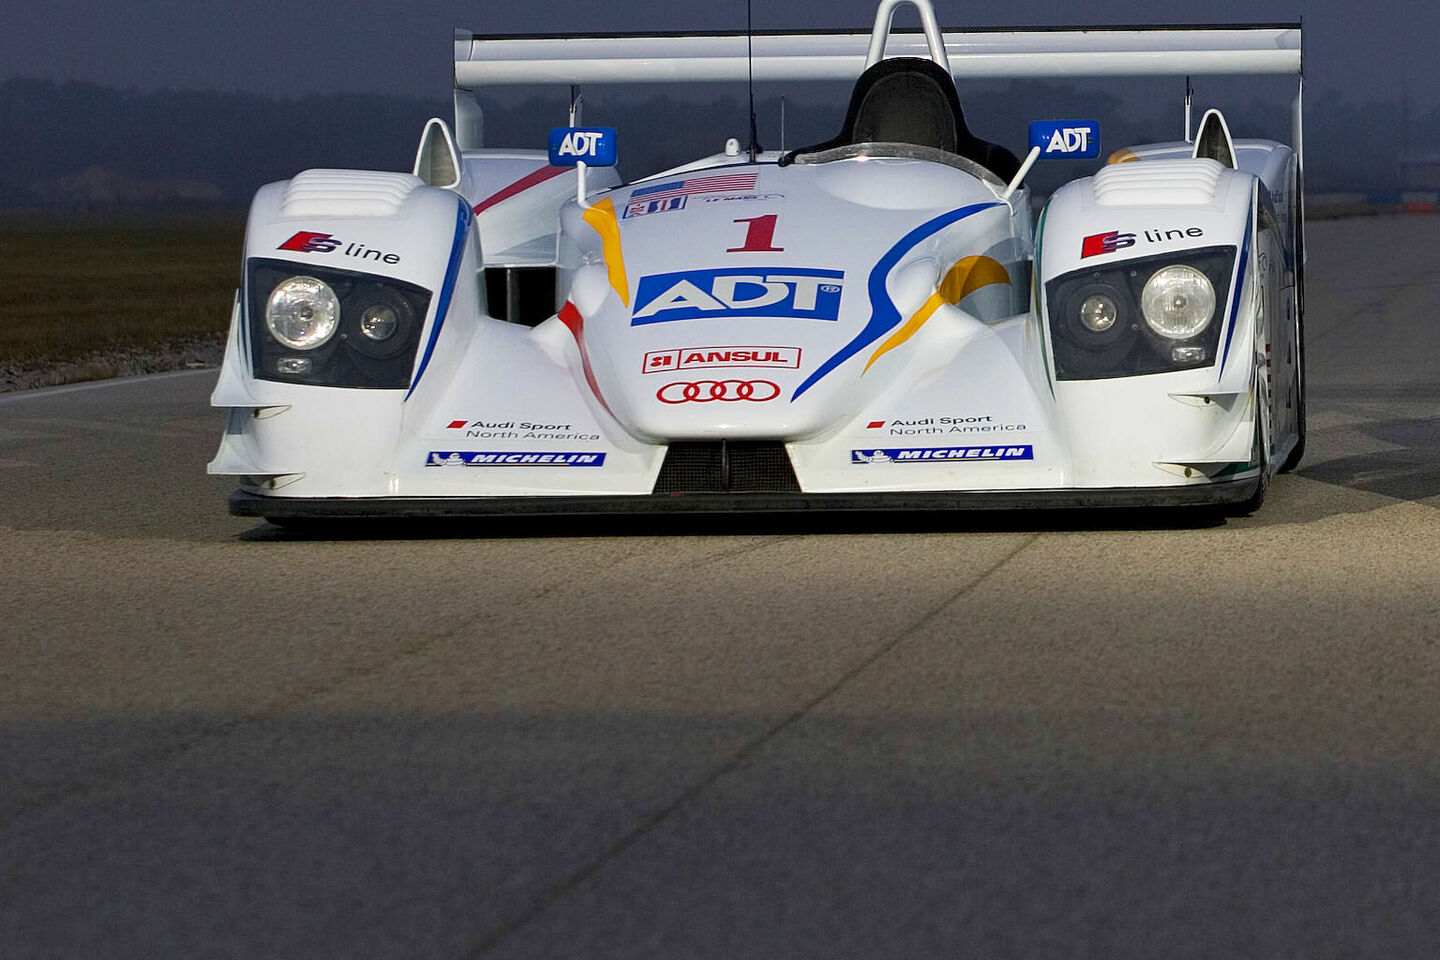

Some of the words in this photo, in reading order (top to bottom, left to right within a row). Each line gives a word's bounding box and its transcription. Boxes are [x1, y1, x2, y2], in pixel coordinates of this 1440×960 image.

[558, 132, 603, 156] ADT
[1045, 127, 1091, 153] ADT
[726, 214, 784, 252] 1
[1144, 227, 1203, 242] line
[345, 243, 400, 264] line
[632, 275, 843, 319] ADT
[684, 351, 788, 364] ANSUL
[471, 421, 515, 429] Audi
[520, 422, 572, 431] Sport
[891, 418, 934, 426] Audi
[940, 416, 992, 425] Sport
[466, 430, 518, 438] North
[522, 431, 600, 440] America
[890, 427, 943, 435] North
[949, 424, 1026, 433] America
[471, 454, 598, 463] MICHELIN
[898, 448, 1025, 459] MICHELIN
